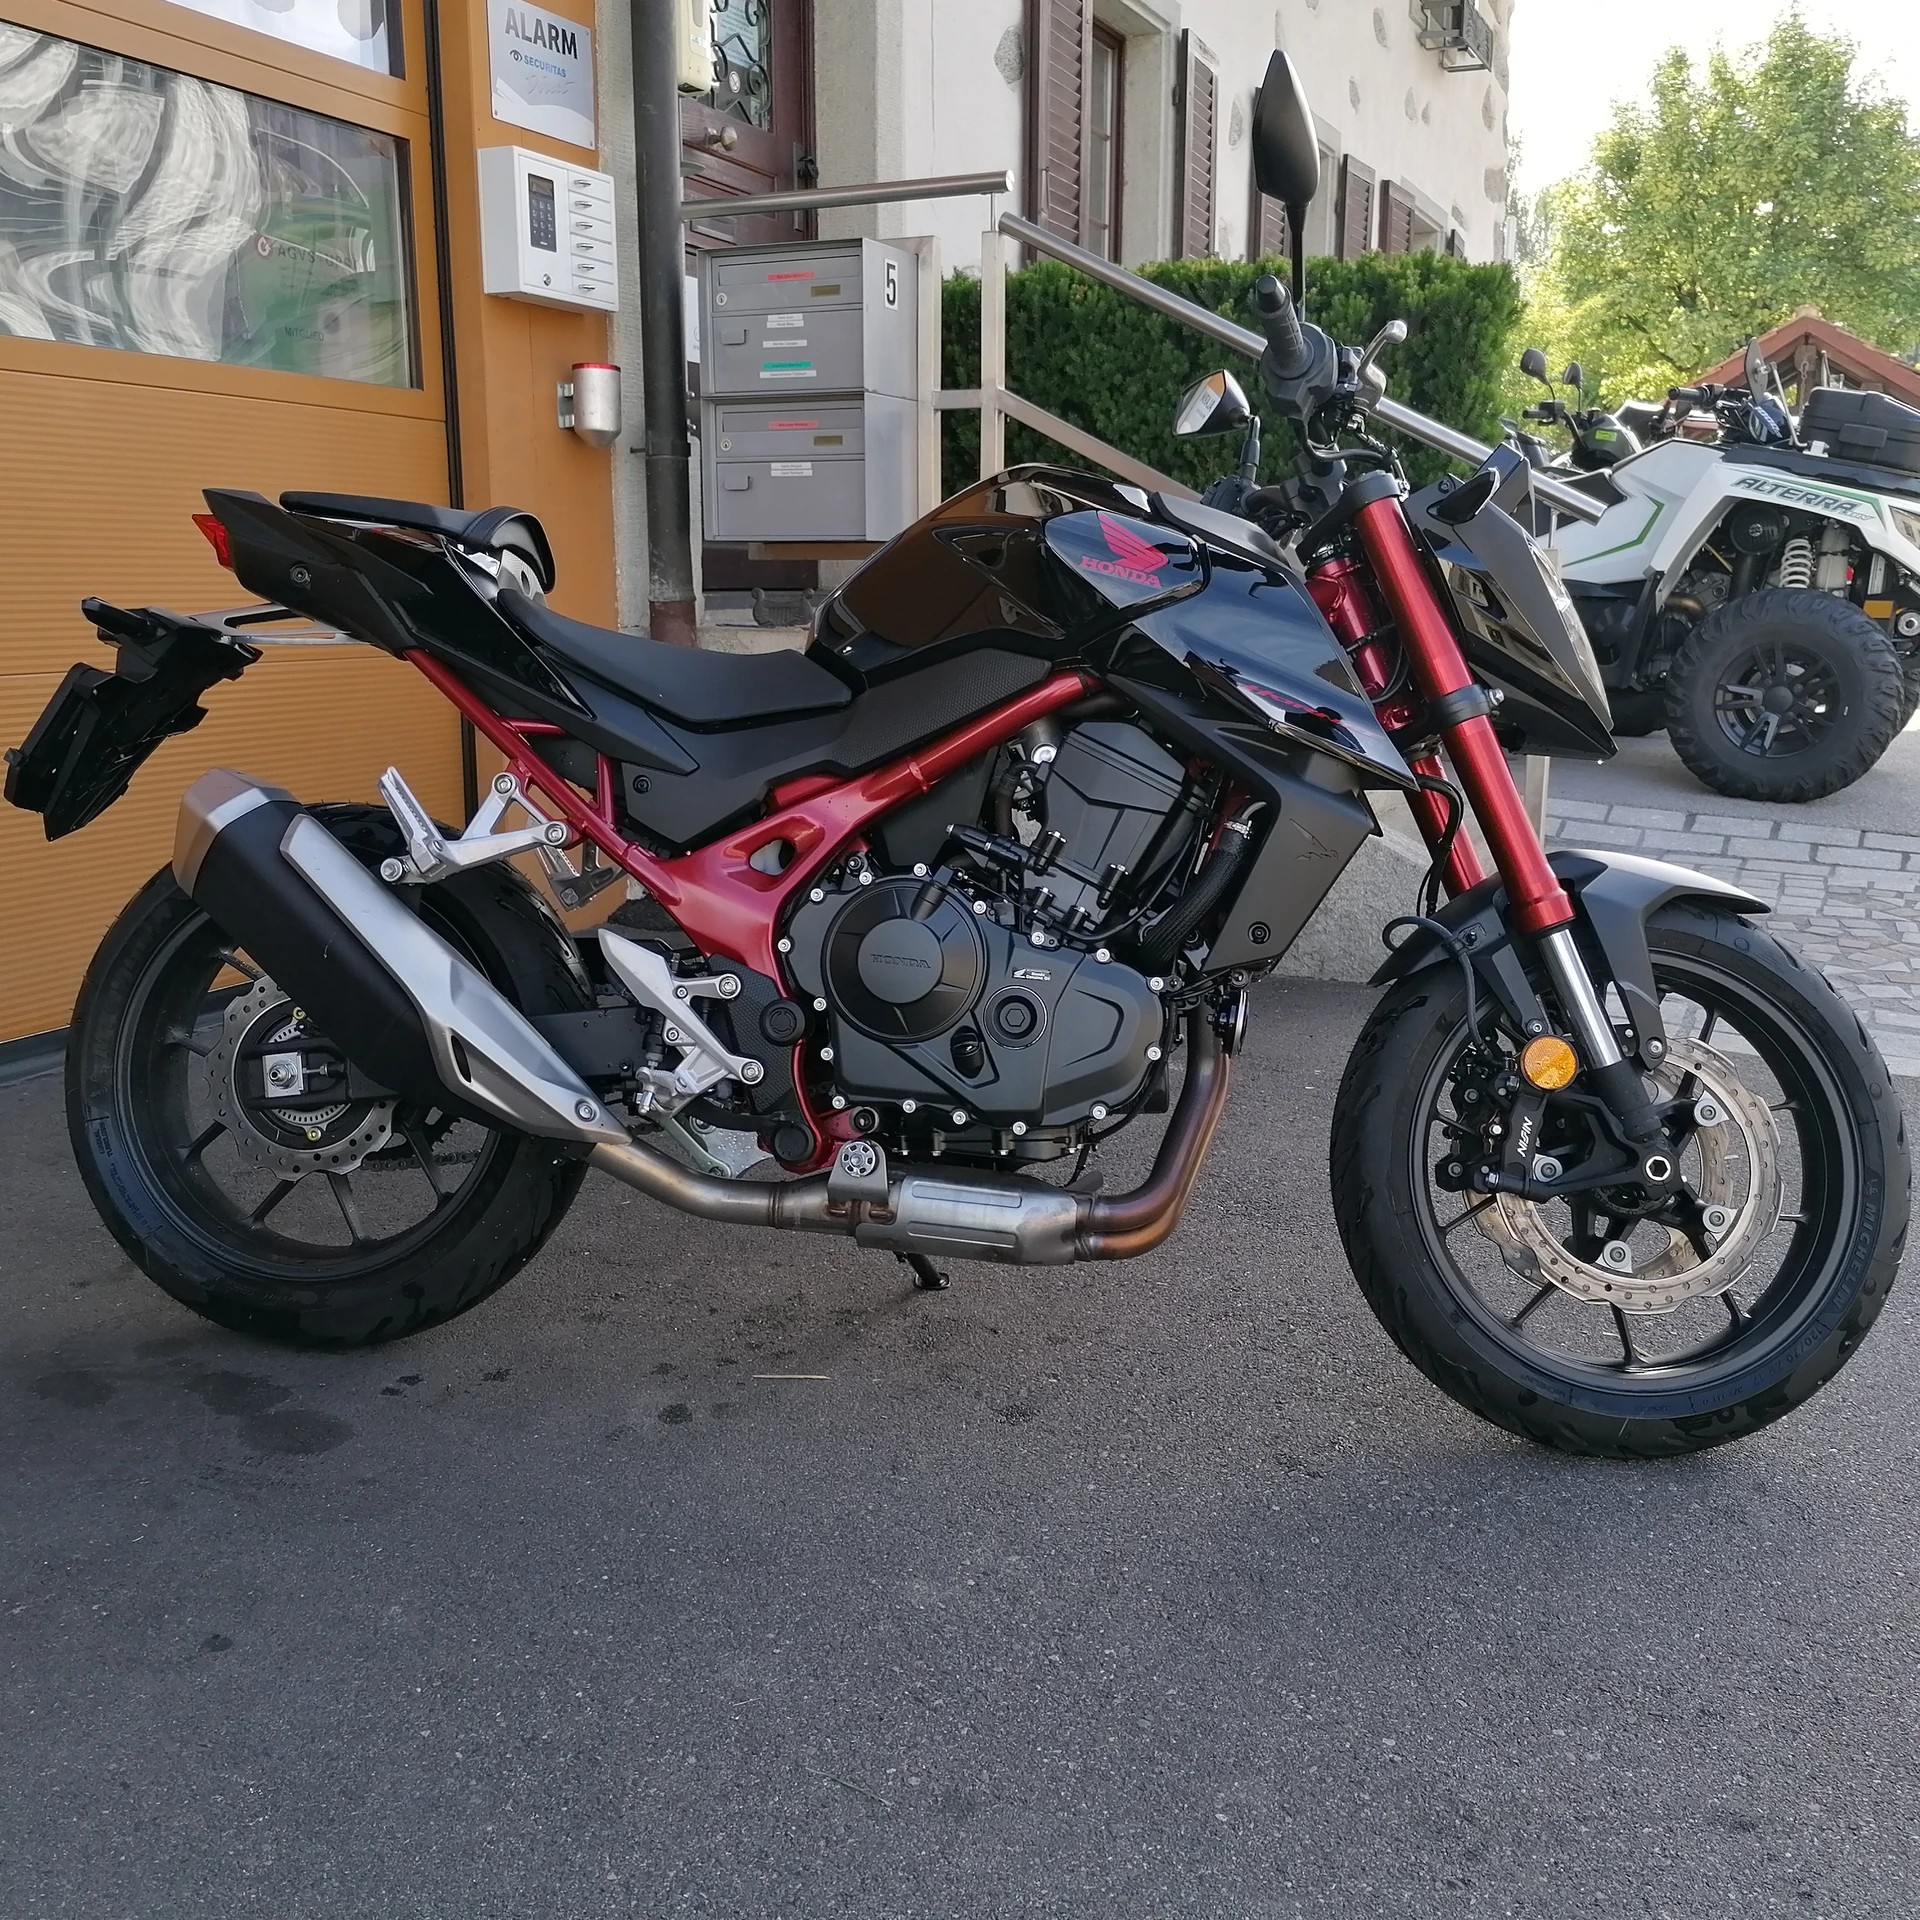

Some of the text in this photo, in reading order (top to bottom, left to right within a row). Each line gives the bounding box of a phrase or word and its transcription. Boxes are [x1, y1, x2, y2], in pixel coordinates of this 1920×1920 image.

[504, 7, 578, 60] ALARM
[523, 54, 567, 78] SECURITAS
[886, 262, 896, 306] 5
[1730, 476, 1862, 514] ALTERRA
[1080, 555, 1162, 590] HONDA
[870, 953, 931, 969] HONDA
[1831, 1202, 1878, 1312] MICHELIN
